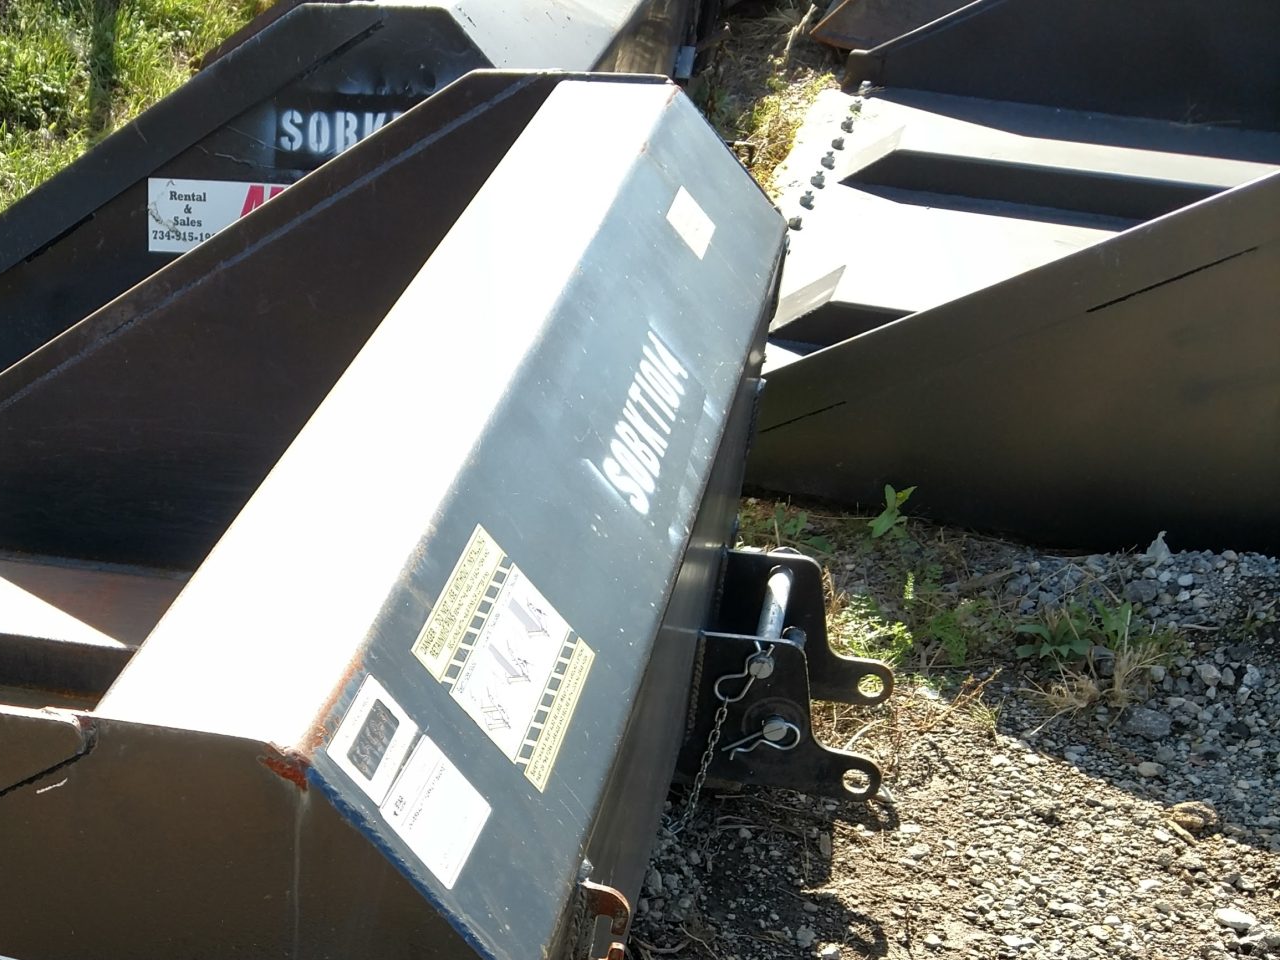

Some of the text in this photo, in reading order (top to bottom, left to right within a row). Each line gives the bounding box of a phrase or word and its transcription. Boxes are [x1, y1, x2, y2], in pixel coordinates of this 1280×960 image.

[169, 190, 206, 202] Rental
[183, 204, 192, 214] &
[173, 216, 202, 227] Sales
